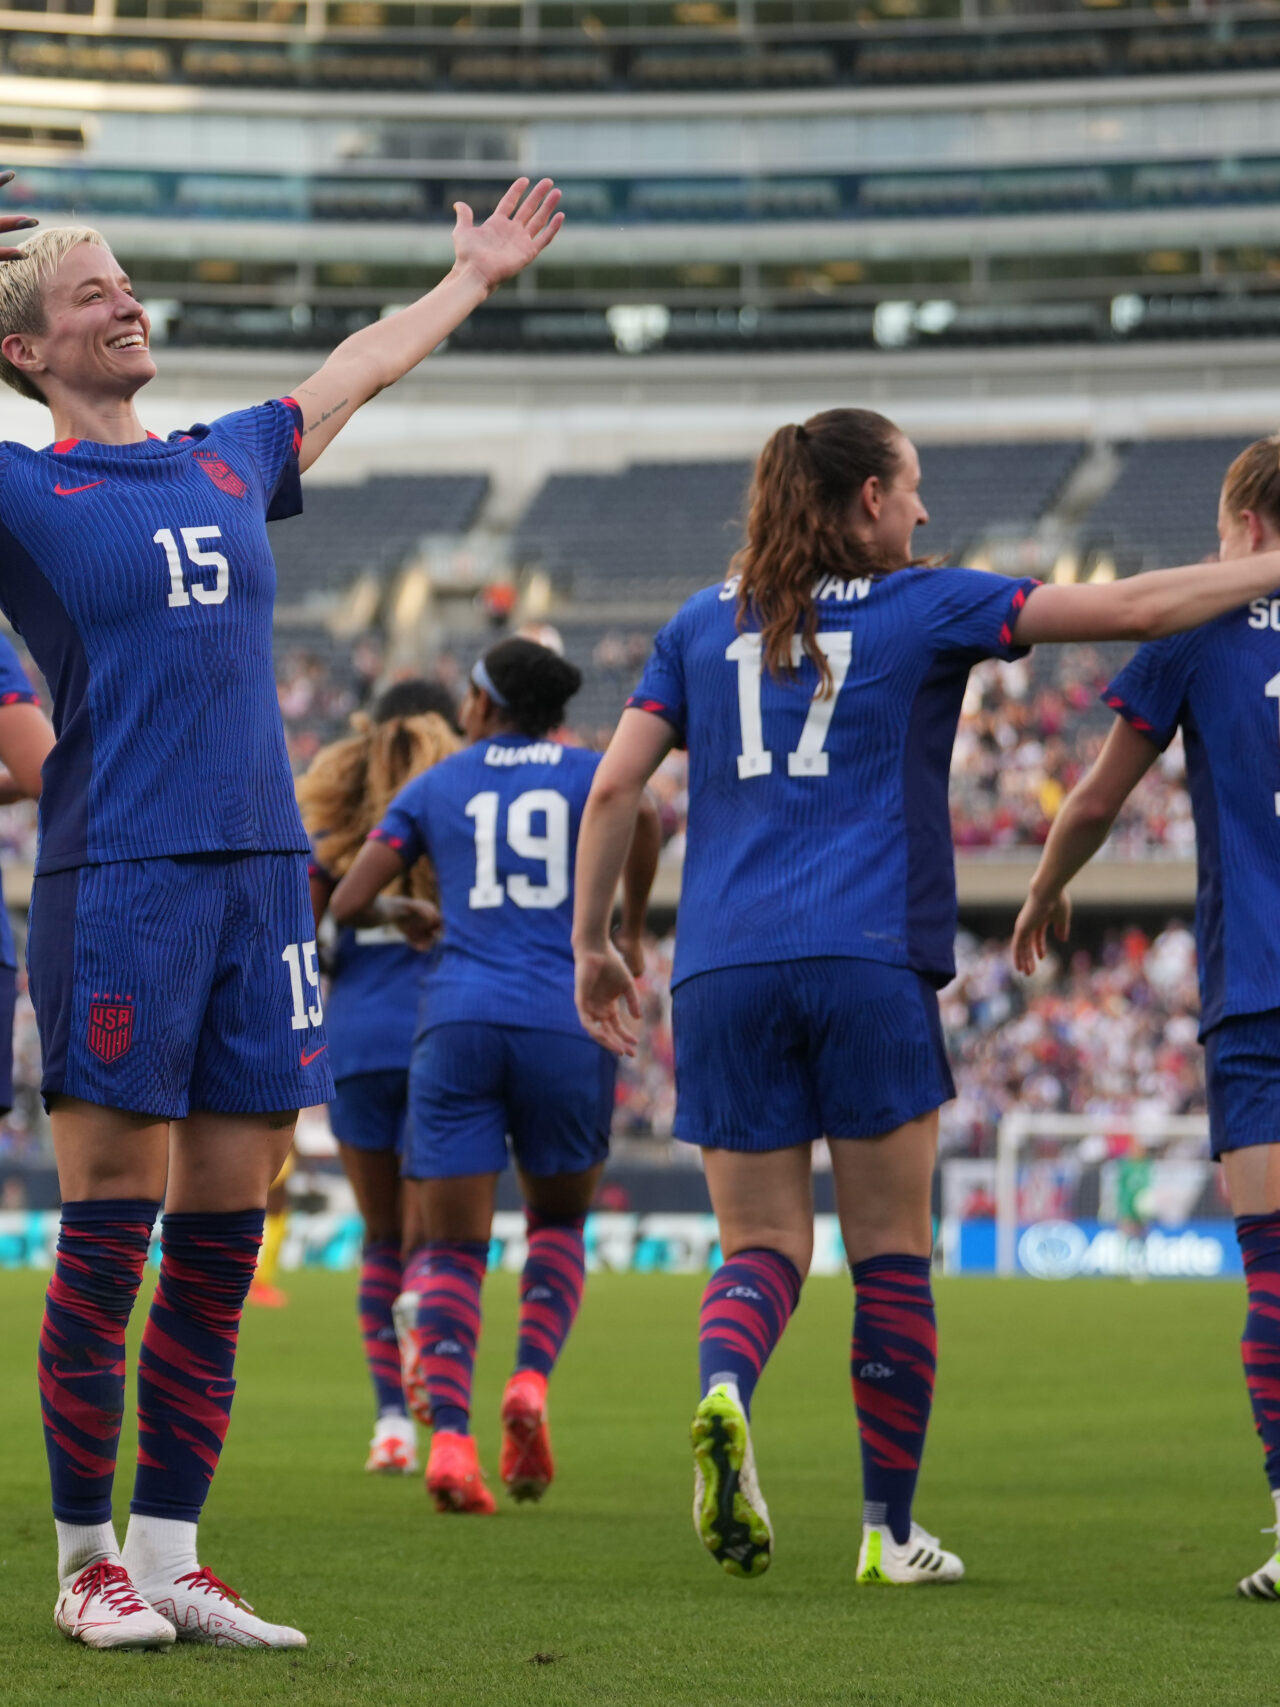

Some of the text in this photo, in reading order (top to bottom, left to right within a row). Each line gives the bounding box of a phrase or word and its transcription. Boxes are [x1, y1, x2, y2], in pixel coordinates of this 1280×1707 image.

[153, 526, 229, 607] 15
[725, 631, 853, 780] 17
[484, 743, 563, 766] DUNN
[465, 789, 569, 909] 19
[93, 1006, 130, 1031] USA
[282, 940, 323, 1030] 15
